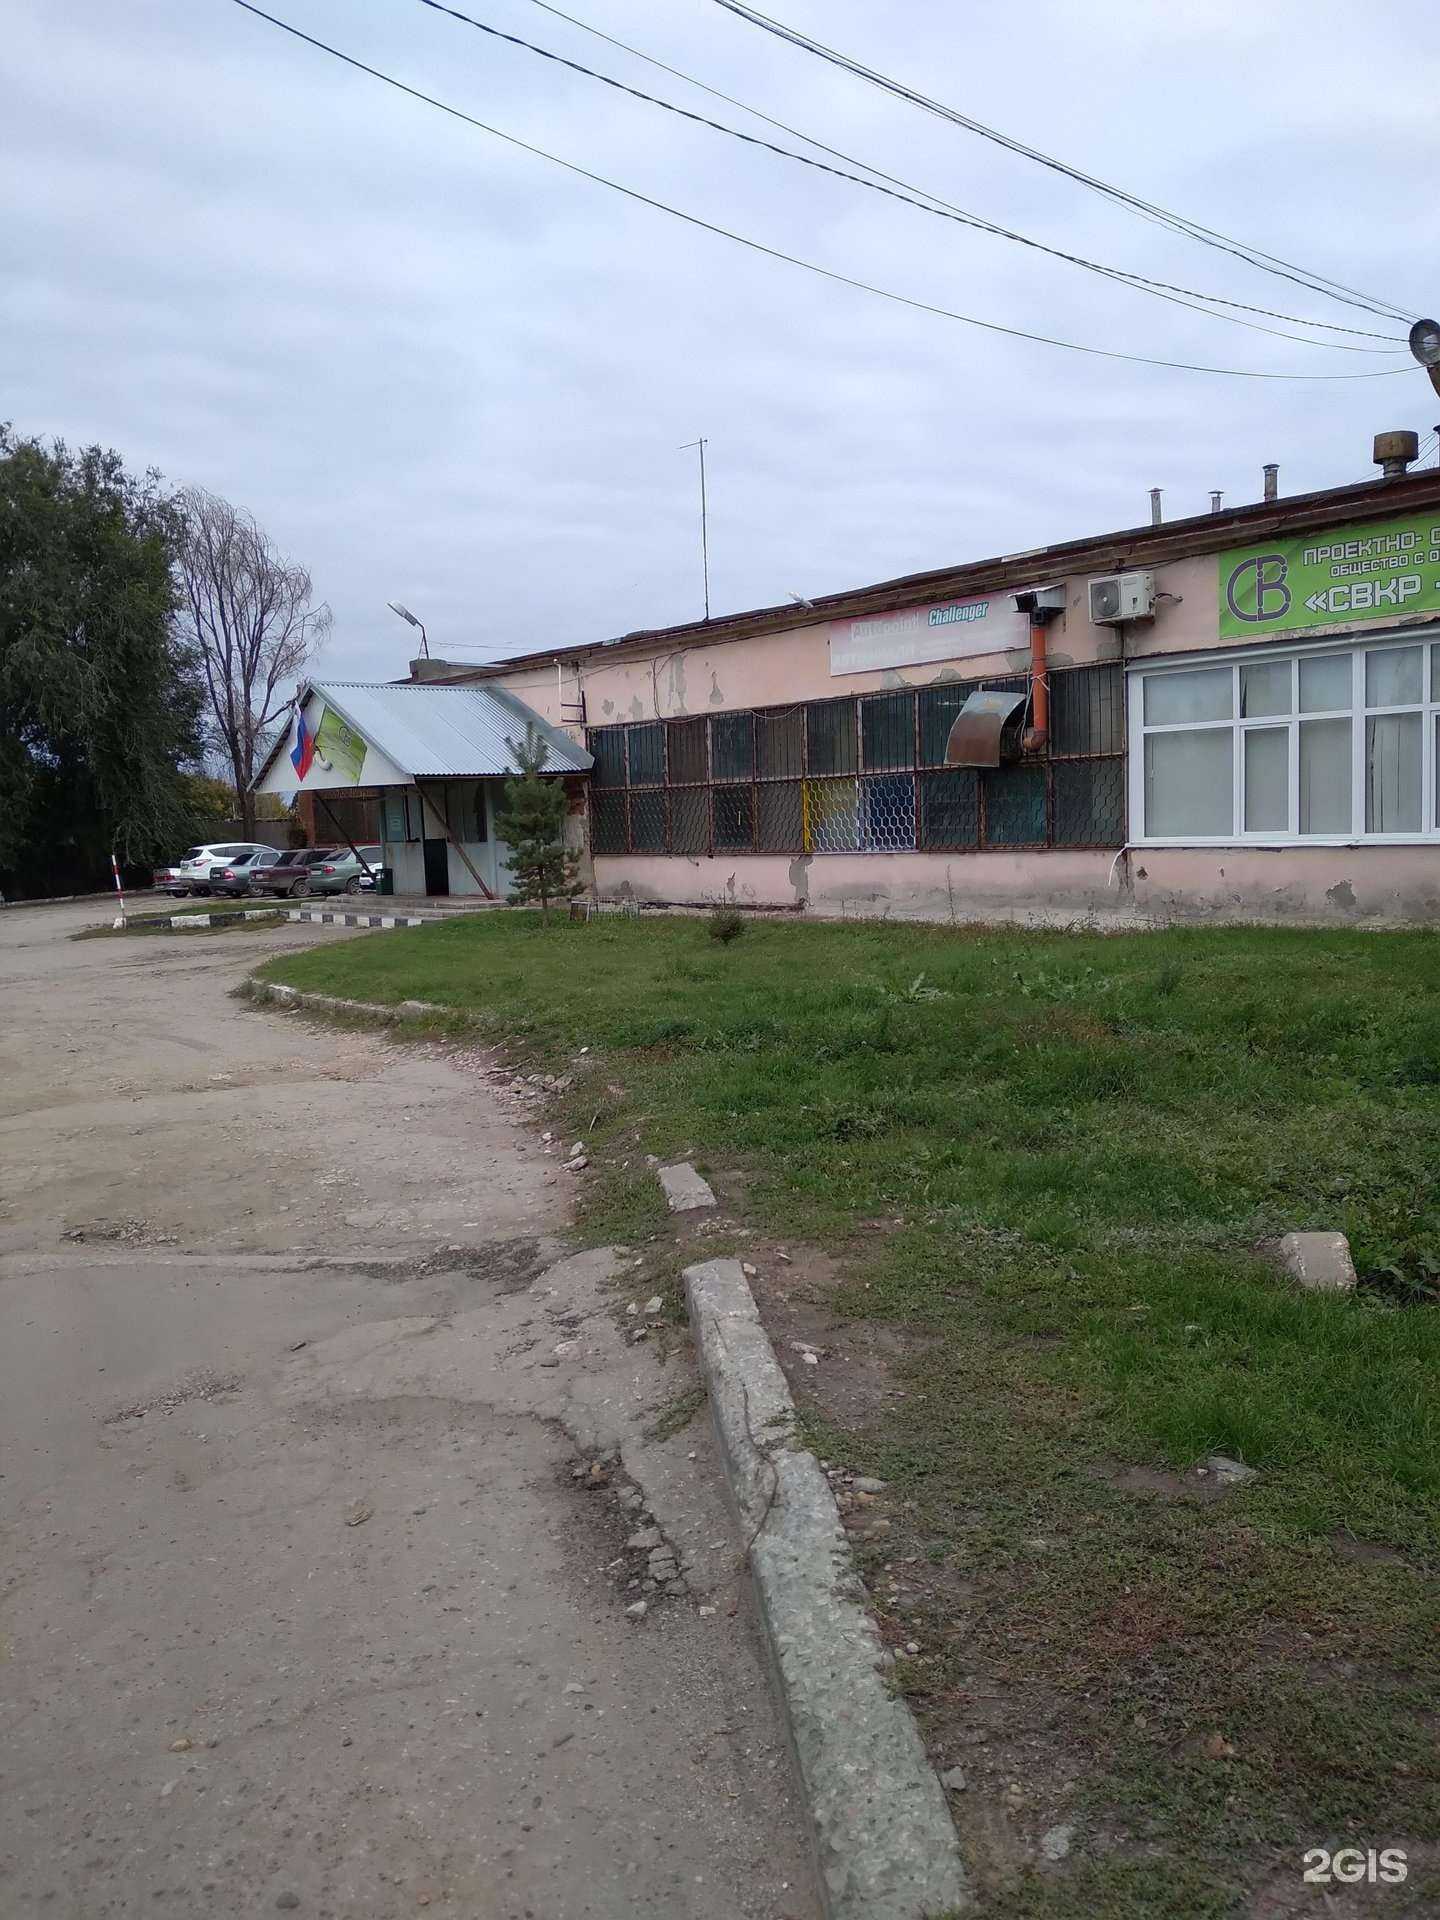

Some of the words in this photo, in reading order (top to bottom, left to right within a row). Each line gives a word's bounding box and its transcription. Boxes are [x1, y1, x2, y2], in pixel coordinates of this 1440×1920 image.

[1303, 531, 1424, 566] ПРОЕКТНО-
[1330, 553, 1409, 578] ОБЩЕСТВО
[1413, 551, 1425, 565] С
[1303, 574, 1422, 613] «СВКР
[928, 602, 989, 627] Challenger
